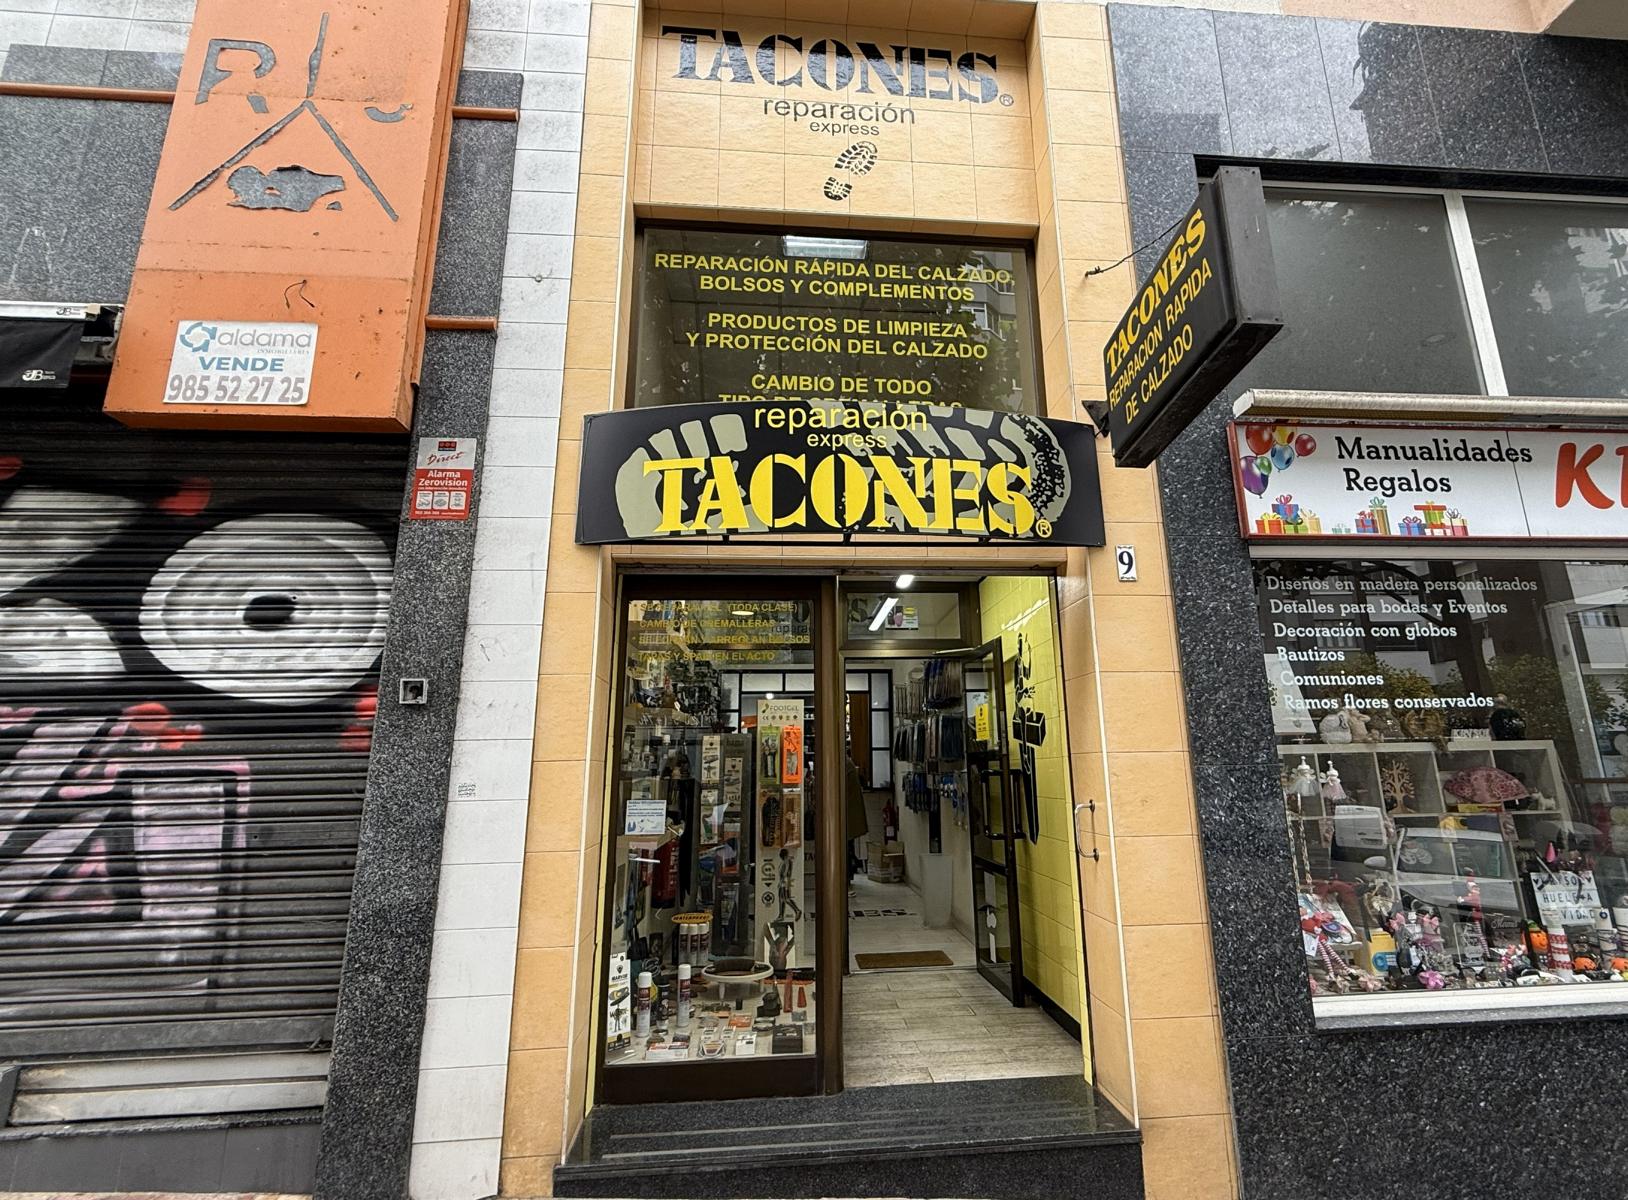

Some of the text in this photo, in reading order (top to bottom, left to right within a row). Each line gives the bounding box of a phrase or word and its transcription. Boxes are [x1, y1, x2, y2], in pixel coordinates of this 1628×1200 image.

[661, 25, 1000, 104] TACONES
[763, 98, 916, 124] reparación
[809, 119, 880, 137] express
[655, 253, 788, 274] REPARACIÓN
[794, 258, 870, 278] RÁPIDA
[874, 263, 911, 280] DEL
[700, 276, 975, 302] BOLSOS Y COMPLEMENTOS
[1106, 209, 1206, 377] TACONES
[217, 328, 312, 348] aldama
[708, 313, 967, 338] PRODUCTOS DE LIMPIEZA
[1109, 257, 1213, 412] REPARACION RAPIDA
[686, 332, 988, 360] Y PROTECCIÓN DEL CALZADO
[199, 356, 285, 372] VENDE
[1125, 323, 1193, 425] DE CALZADO
[168, 374, 305, 403] 985 52 27 25
[751, 374, 932, 395] CAMBIO DE TODO
[754, 402, 928, 434] reparación
[806, 432, 887, 451] express
[1334, 435, 1533, 463] Manualidades
[428, 470, 461, 478] Alarma
[1343, 467, 1452, 497] Regalos
[644, 453, 1034, 535] TACONES
[1118, 550, 1133, 575] 9
[1267, 576, 1538, 594] Diseños en madera personalizados
[1270, 599, 1508, 618] Detalles para bodas y Eventos
[1273, 622, 1458, 641] Decoración con globos
[1277, 647, 1345, 662] Bautizos
[1280, 672, 1384, 687] Comuniones
[1283, 694, 1495, 710] Ramos flores conservados
